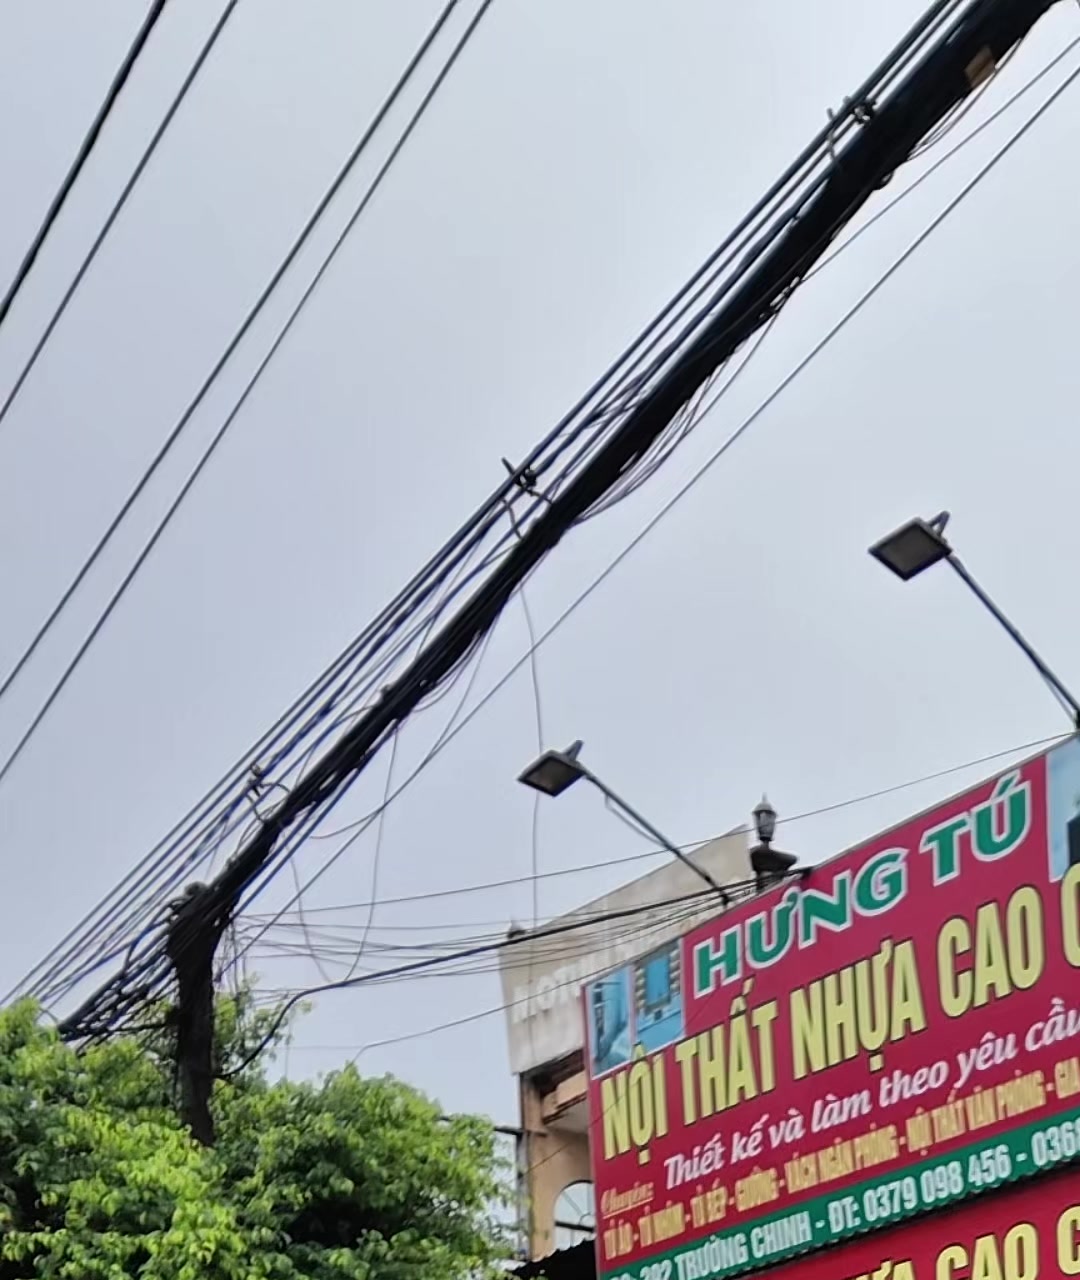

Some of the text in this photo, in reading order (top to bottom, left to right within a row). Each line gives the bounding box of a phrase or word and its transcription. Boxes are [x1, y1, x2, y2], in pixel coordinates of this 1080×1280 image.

[693, 846, 908, 999] HƯNG
[919, 768, 1032, 887] TÚ
[601, 1043, 668, 1165] NỘI
[675, 975, 778, 1126] THẤT
[789, 935, 927, 1080] NHỰA
[936, 886, 1045, 1019] CAO
[664, 1132, 726, 1189] Thiết
[730, 1114, 769, 1164] kế
[769, 1107, 805, 1149] và
[811, 1093, 872, 1133] làm
[879, 1060, 949, 1107] theo
[952, 1031, 1018, 1089] yêu
[750, 1210, 813, 1258] CHINH
[827, 1195, 861, 1234] ĐT:
[863, 1176, 917, 1222] 0379
[920, 1161, 963, 1204] 098
[968, 1145, 1012, 1187] 456
